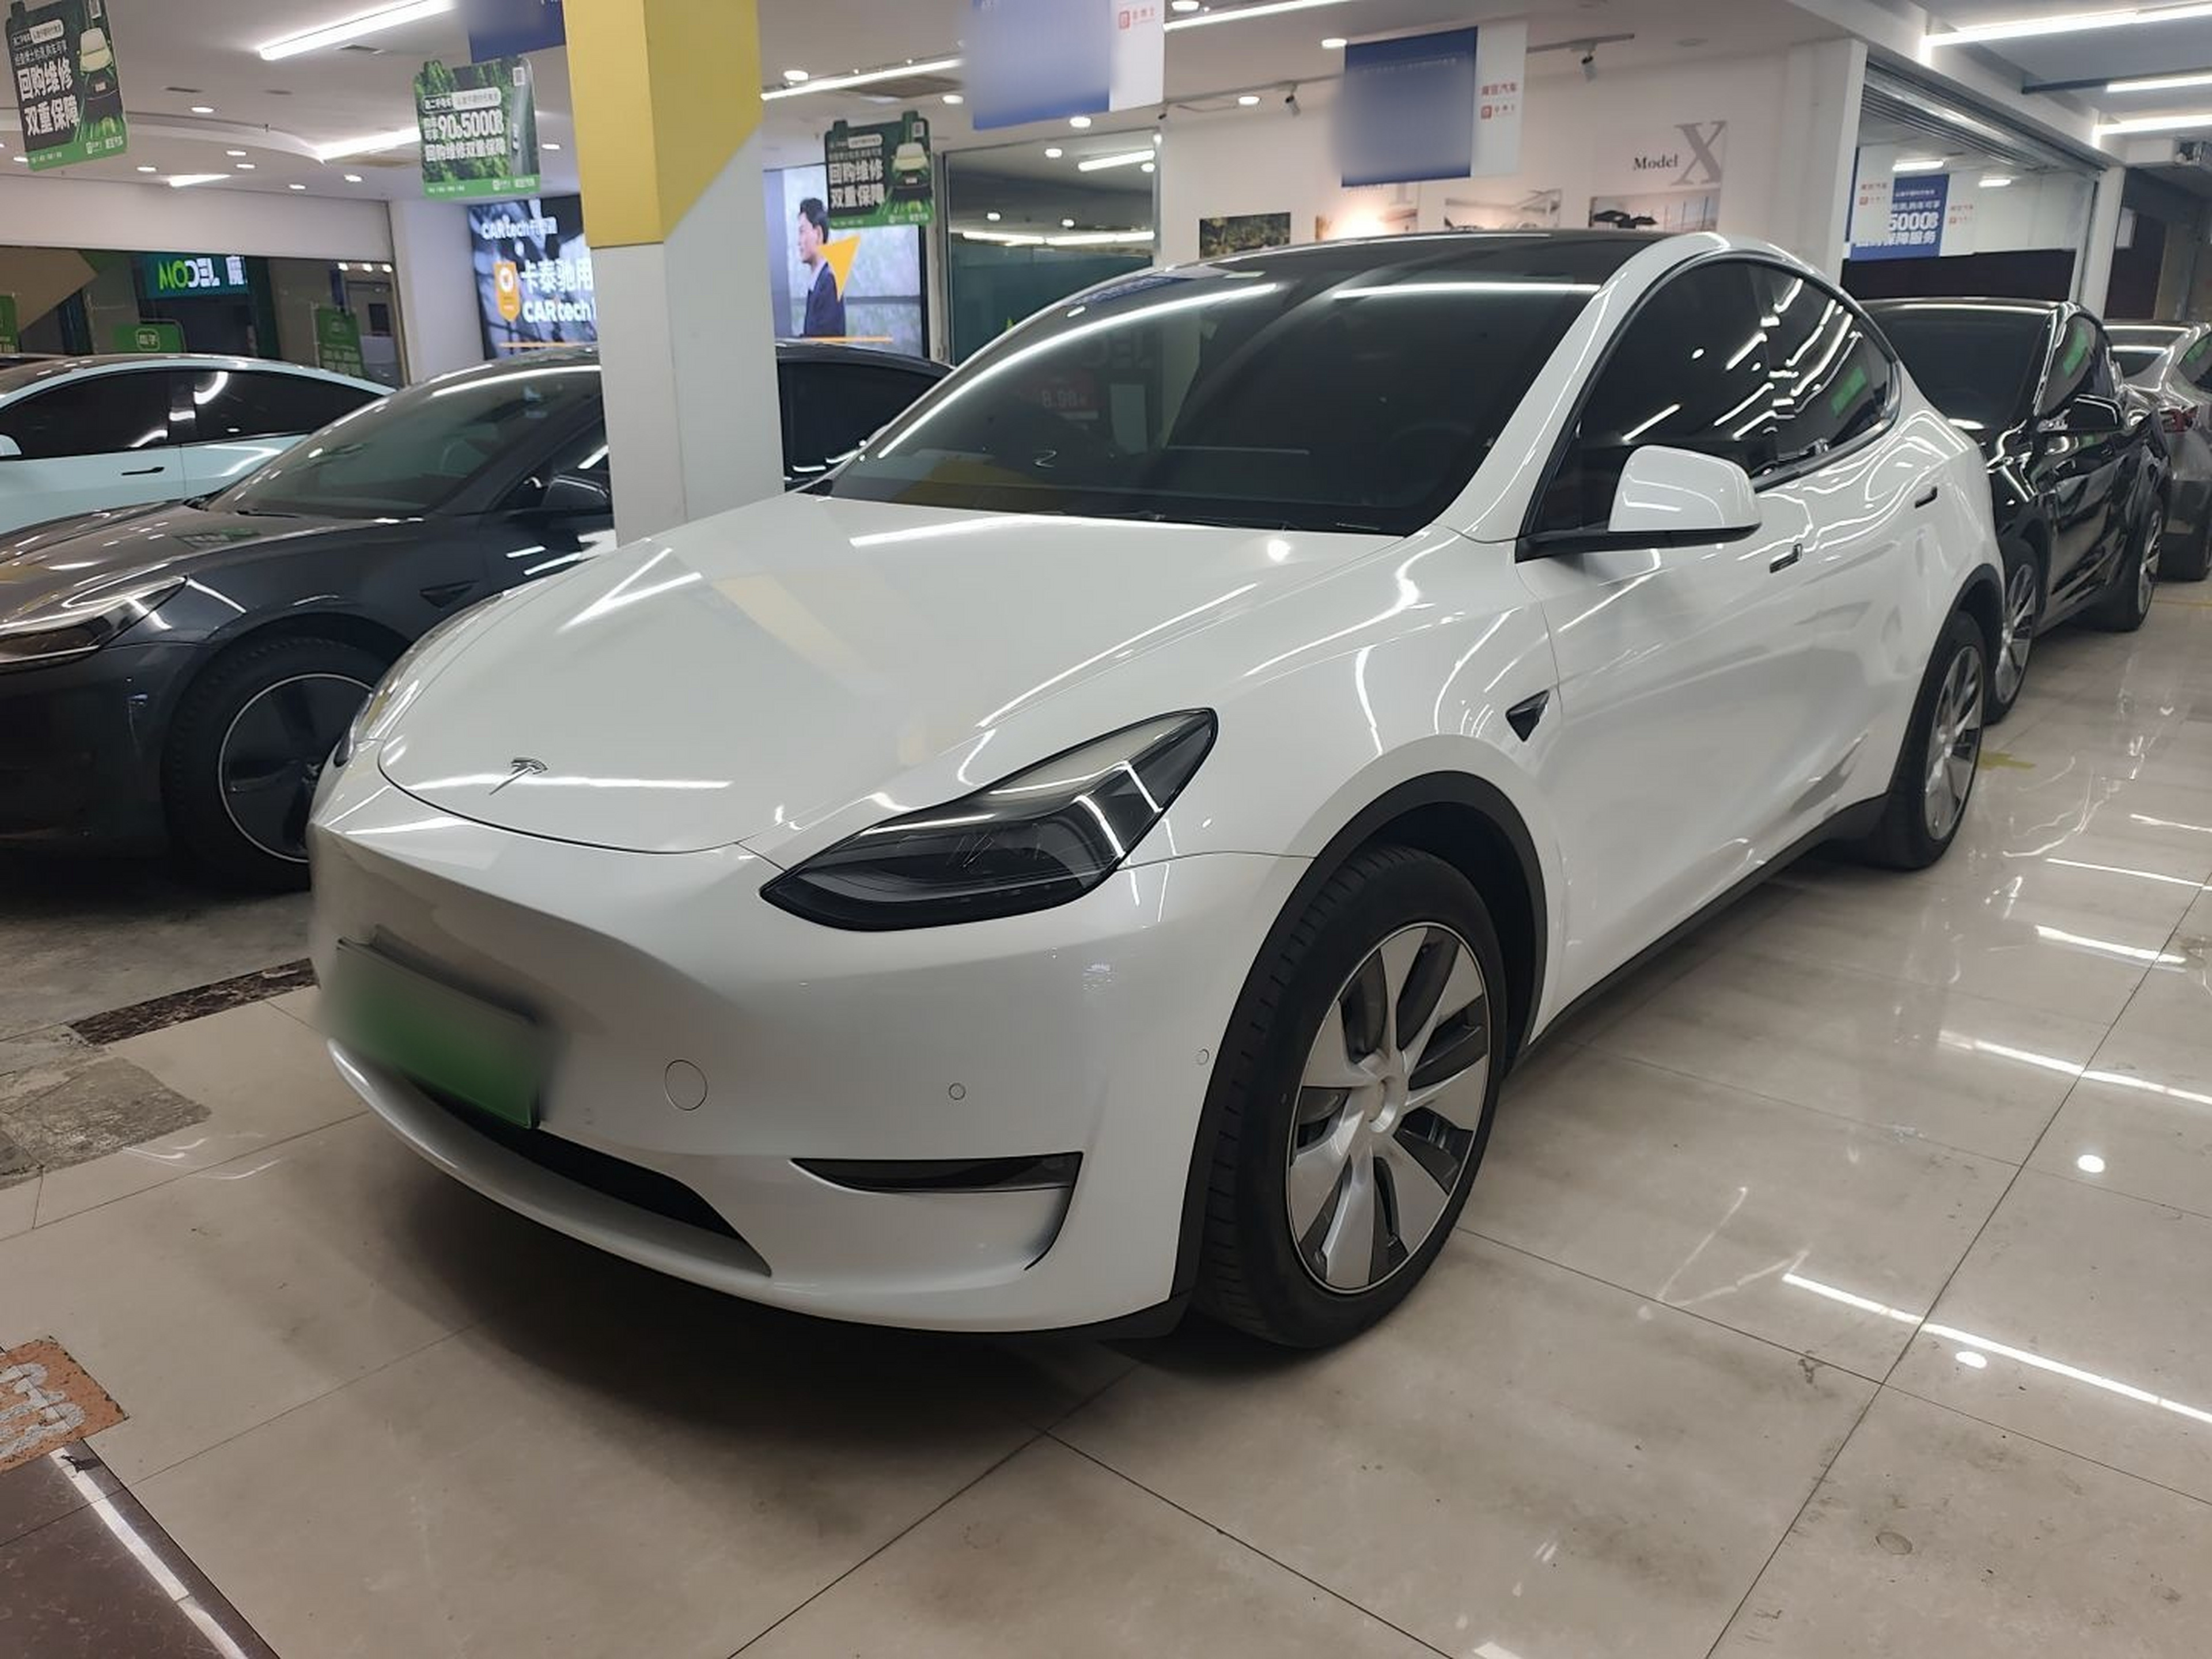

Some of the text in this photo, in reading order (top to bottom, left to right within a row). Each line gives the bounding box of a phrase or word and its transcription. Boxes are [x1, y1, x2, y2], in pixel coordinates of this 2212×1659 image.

[17, 56, 73, 101] 回购维修
[25, 94, 79, 136] 双重保障
[829, 159, 884, 184] 回购维修
[1633, 120, 1727, 186] Model X
[831, 183, 885, 209] 双重保障
